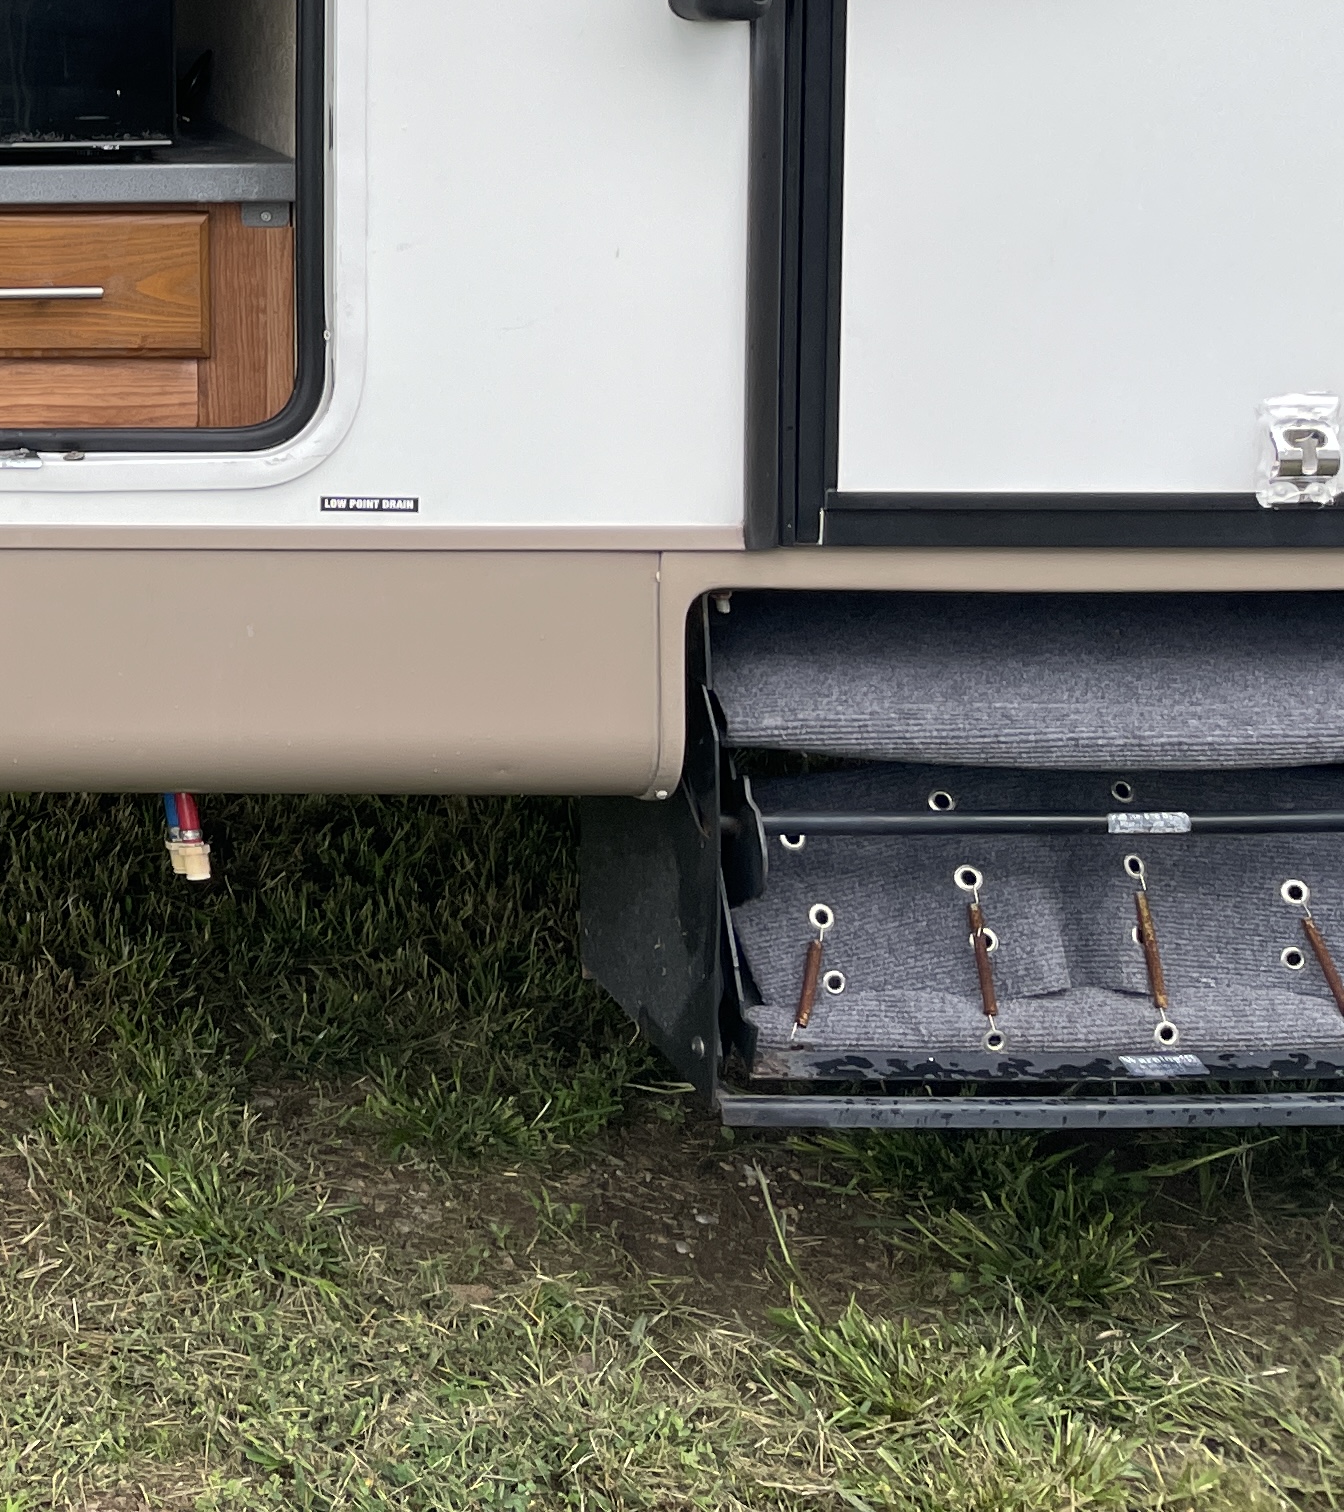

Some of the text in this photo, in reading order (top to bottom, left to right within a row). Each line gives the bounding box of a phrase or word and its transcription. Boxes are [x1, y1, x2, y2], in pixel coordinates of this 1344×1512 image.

[324, 498, 414, 509] LOW POINT DRAIN
